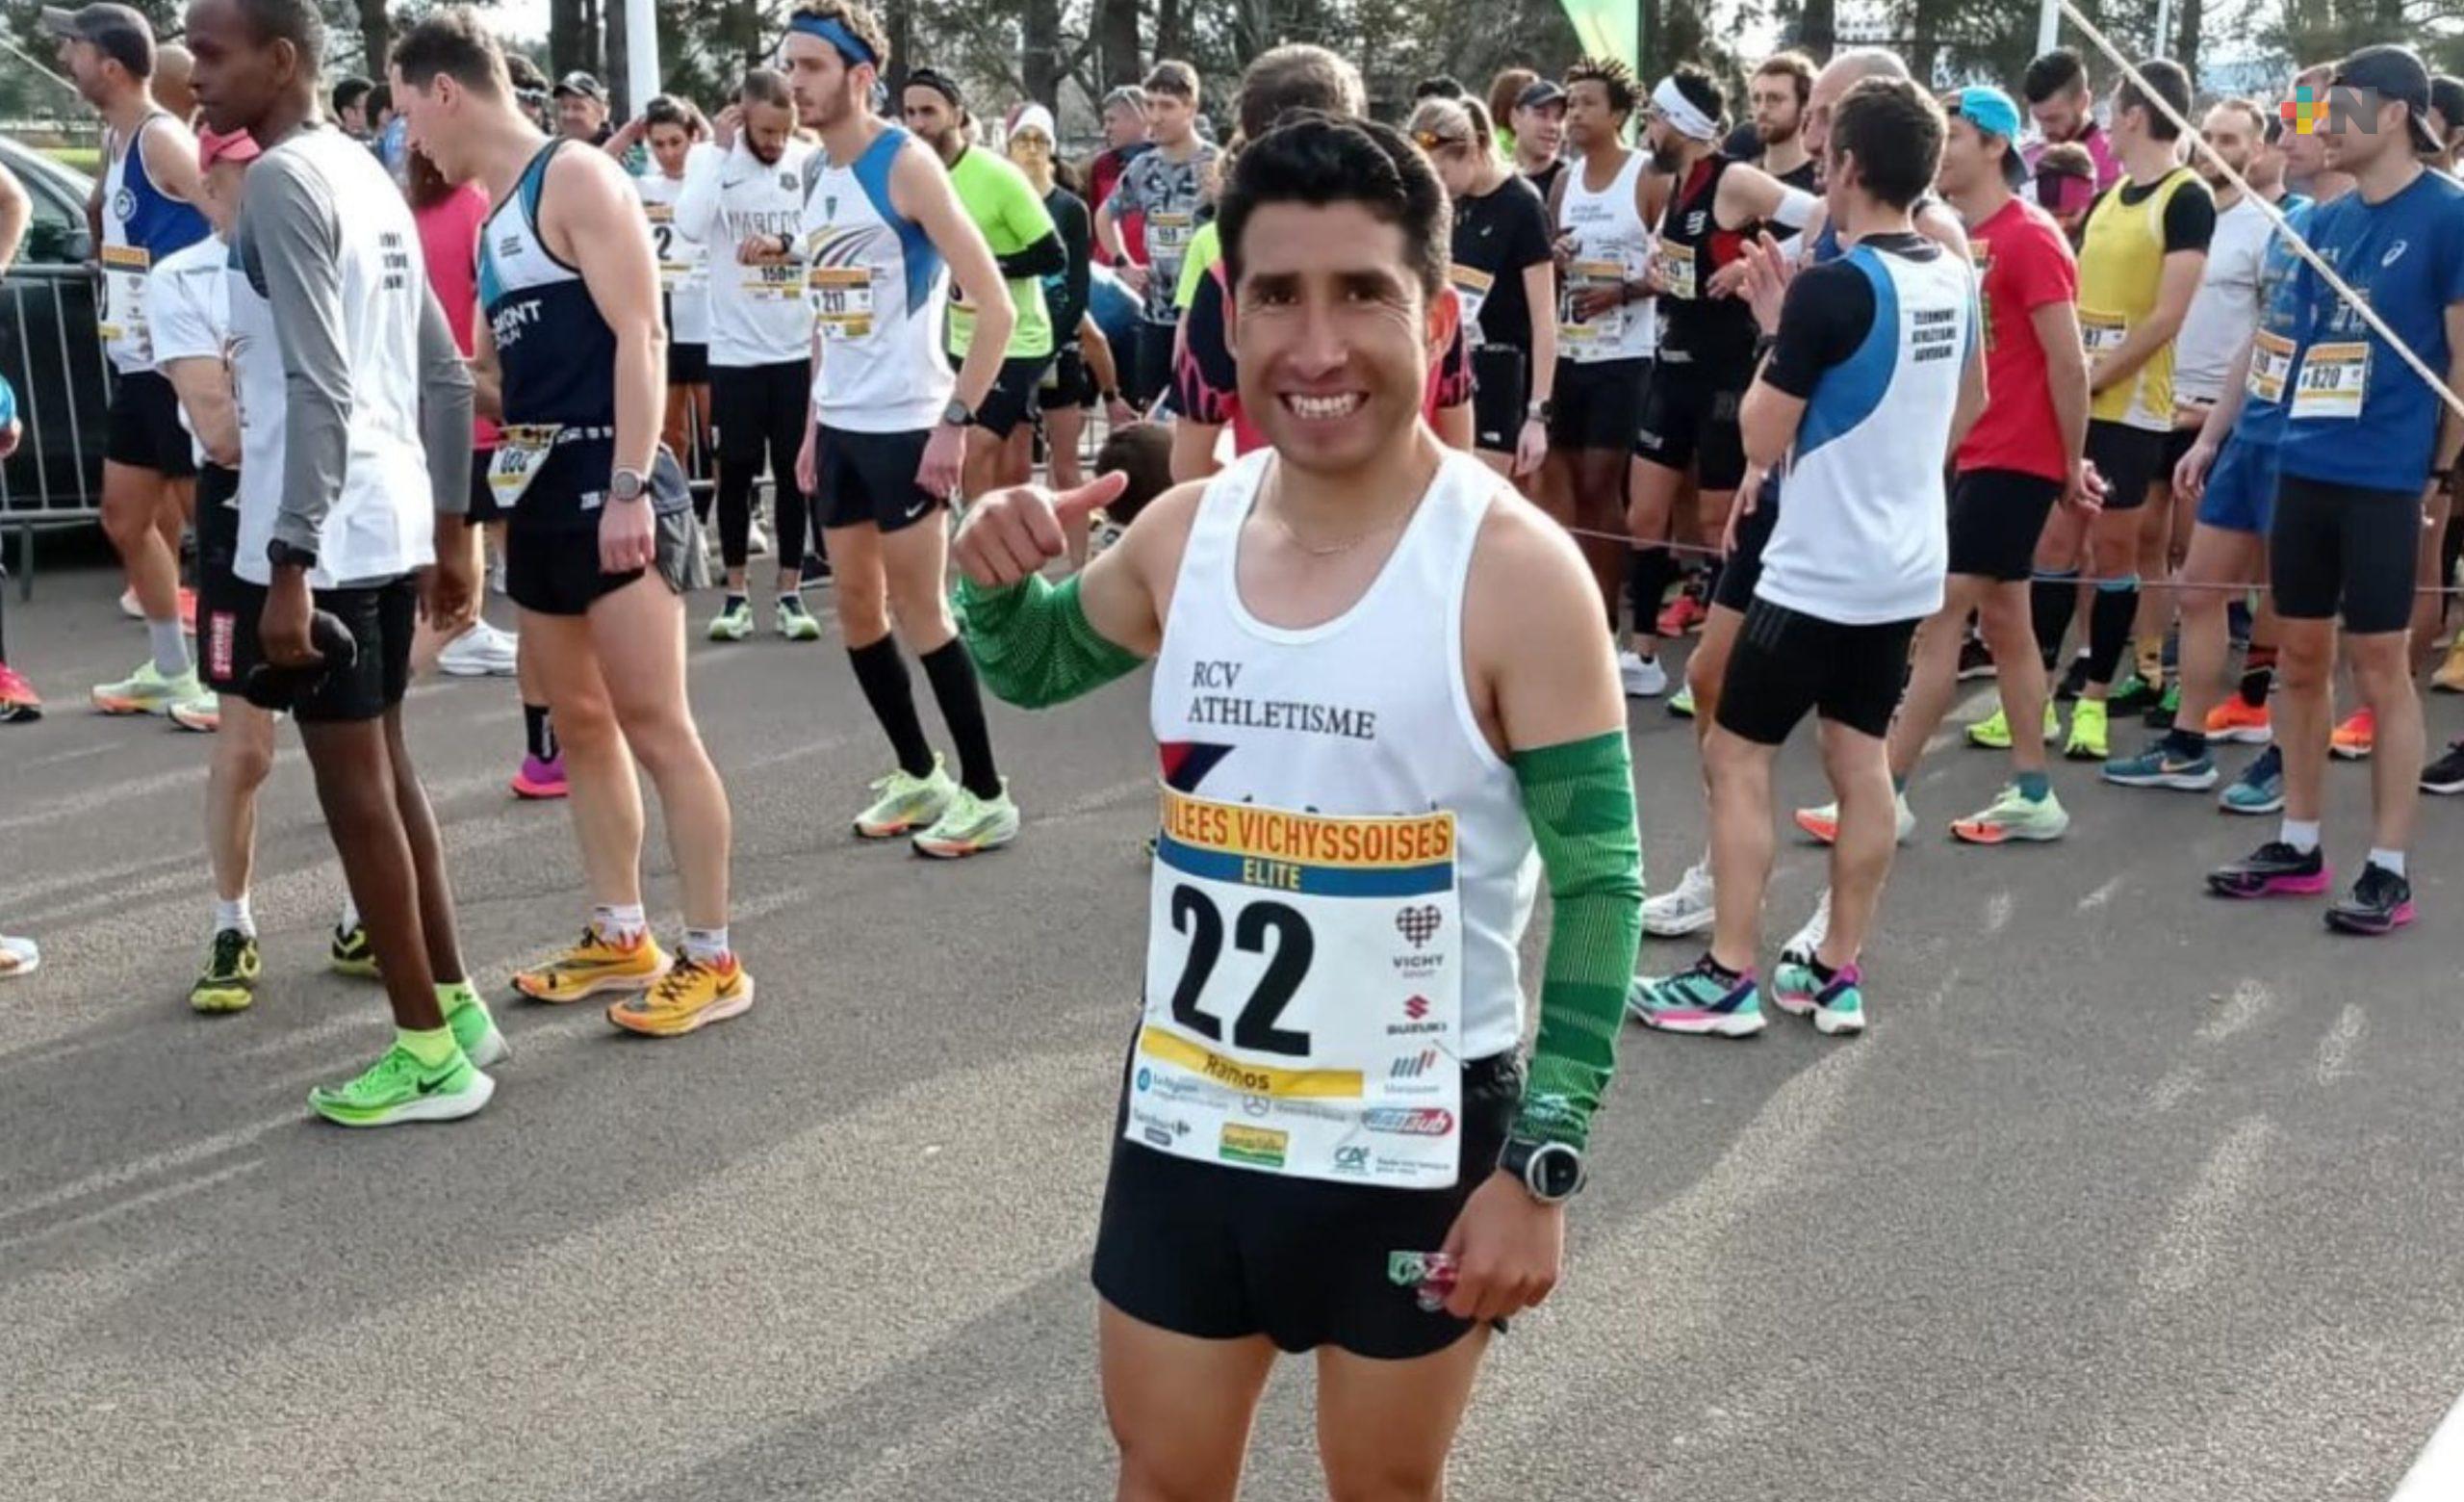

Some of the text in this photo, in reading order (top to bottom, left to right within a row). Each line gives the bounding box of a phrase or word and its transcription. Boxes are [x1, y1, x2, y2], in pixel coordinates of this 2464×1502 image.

[1192, 660, 1243, 688] RCV
[1187, 695, 1376, 740] ATHLETISME
[1238, 810, 1449, 862] VICHYSSOISES
[1243, 858, 1300, 890] ELITE
[1171, 882, 1316, 1057] 22
[1393, 953, 1444, 969] VICHY
[1387, 1022, 1448, 1035] SUZUKI
[1203, 1052, 1270, 1091] Ramos
